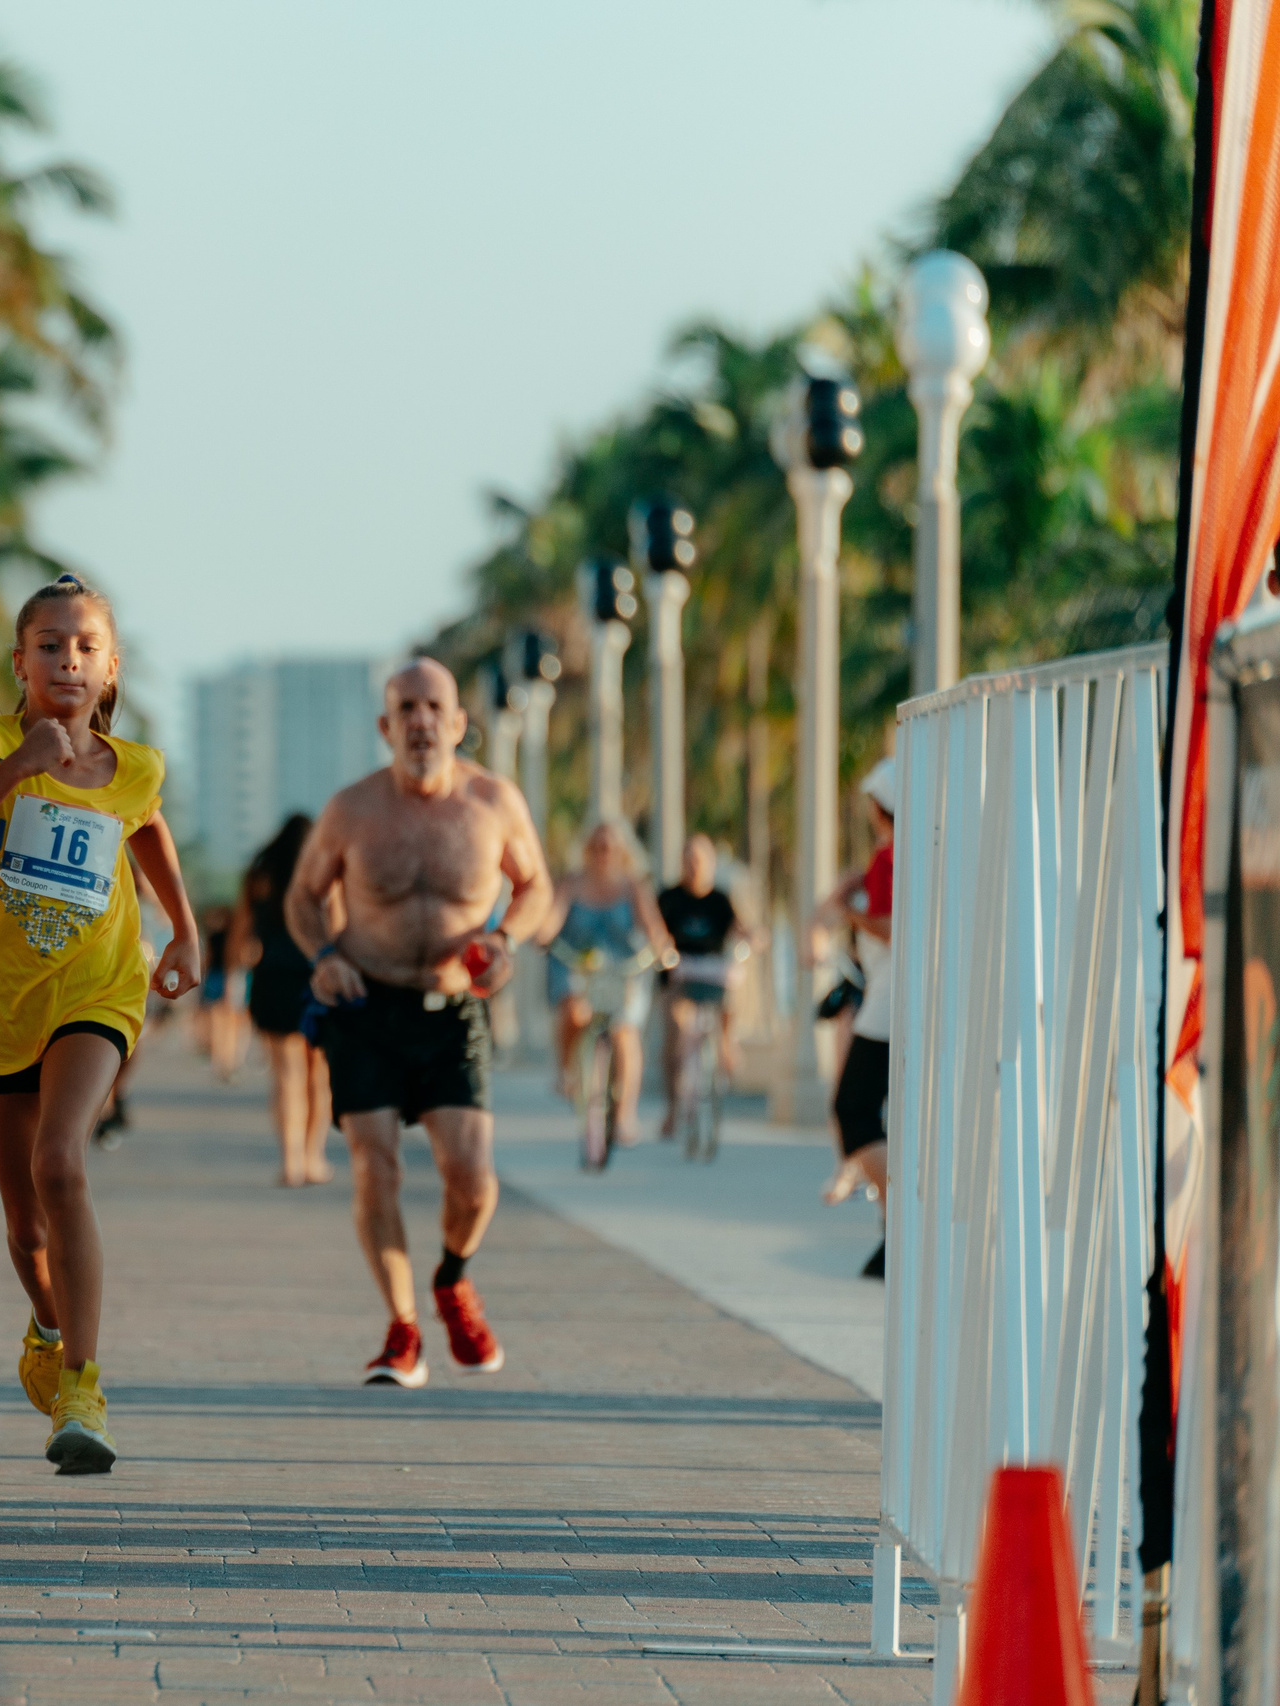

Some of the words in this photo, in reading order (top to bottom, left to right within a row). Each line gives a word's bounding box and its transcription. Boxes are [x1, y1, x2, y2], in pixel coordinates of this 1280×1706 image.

[51, 824, 90, 866] 16
[1, 872, 20, 885] Photo
[21, 877, 48, 891] Coupon
